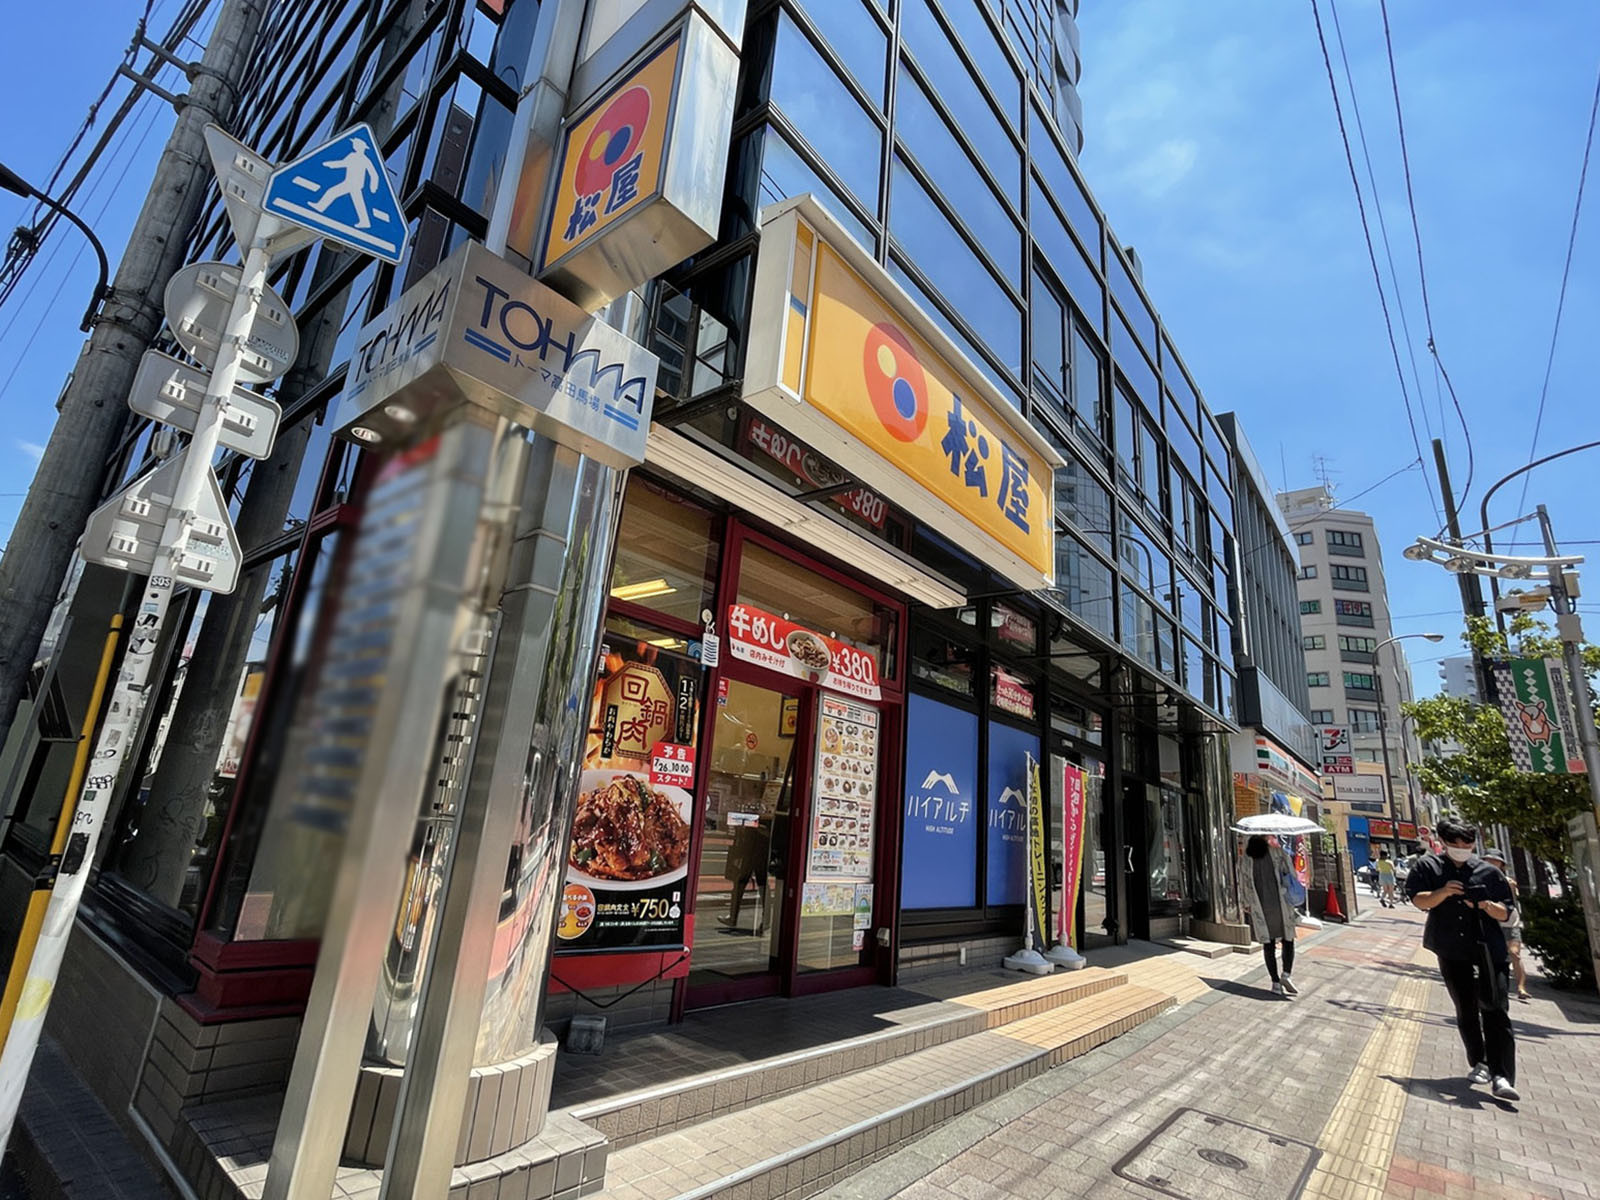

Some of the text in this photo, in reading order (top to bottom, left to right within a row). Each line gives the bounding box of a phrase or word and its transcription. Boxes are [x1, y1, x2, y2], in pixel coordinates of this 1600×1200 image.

[564, 151, 644, 241] 松屋
[355, 277, 452, 383] TOHMA
[476, 275, 648, 415] TOHMA
[510, 354, 600, 412] トーマ高田馬場
[941, 391, 1030, 536] 松屋
[731, 606, 875, 685] 牛めし ¥380
[615, 672, 669, 750] 回鍋肉
[664, 745, 687, 760] 予告
[1328, 765, 1350, 773] ATM
[907, 795, 969, 823] ハイアルチ
[989, 808, 1026, 832] ハイアル
[631, 898, 669, 919] ¥750
